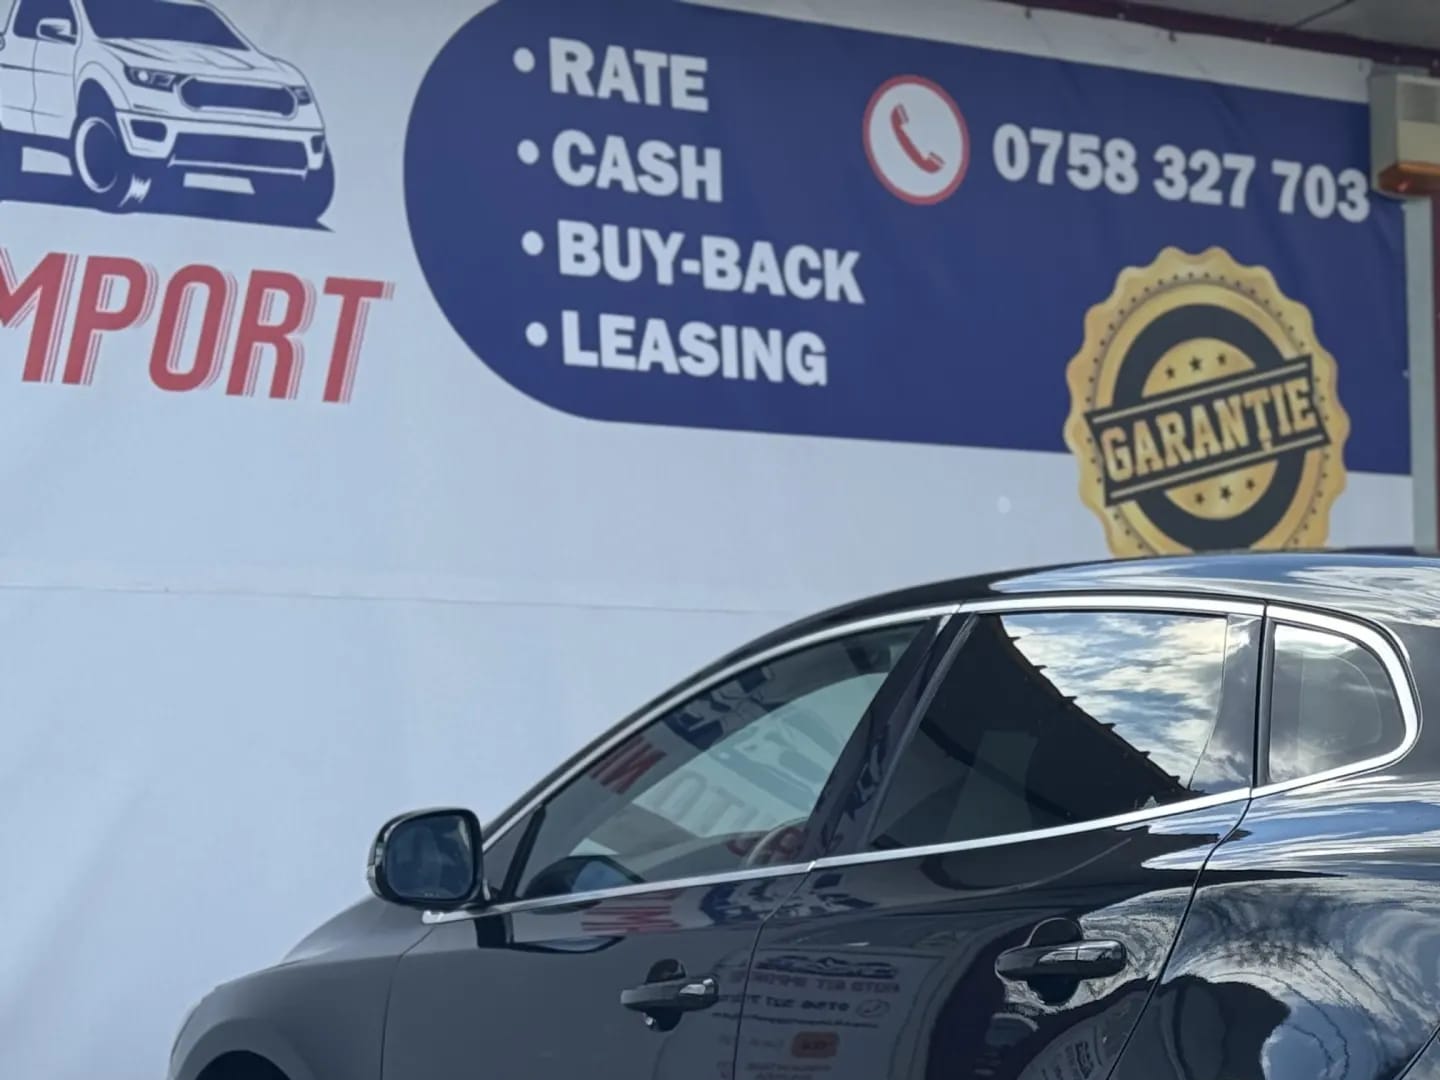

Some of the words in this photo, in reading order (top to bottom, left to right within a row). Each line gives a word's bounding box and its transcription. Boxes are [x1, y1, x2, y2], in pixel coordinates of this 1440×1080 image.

[549, 37, 708, 112] RATE
[552, 129, 723, 202] CASH
[993, 124, 1139, 195] 0758
[1153, 145, 1256, 208] 327
[1271, 163, 1370, 223] 703
[558, 219, 865, 304] BUY-BACK
[561, 309, 828, 387] LEASING
